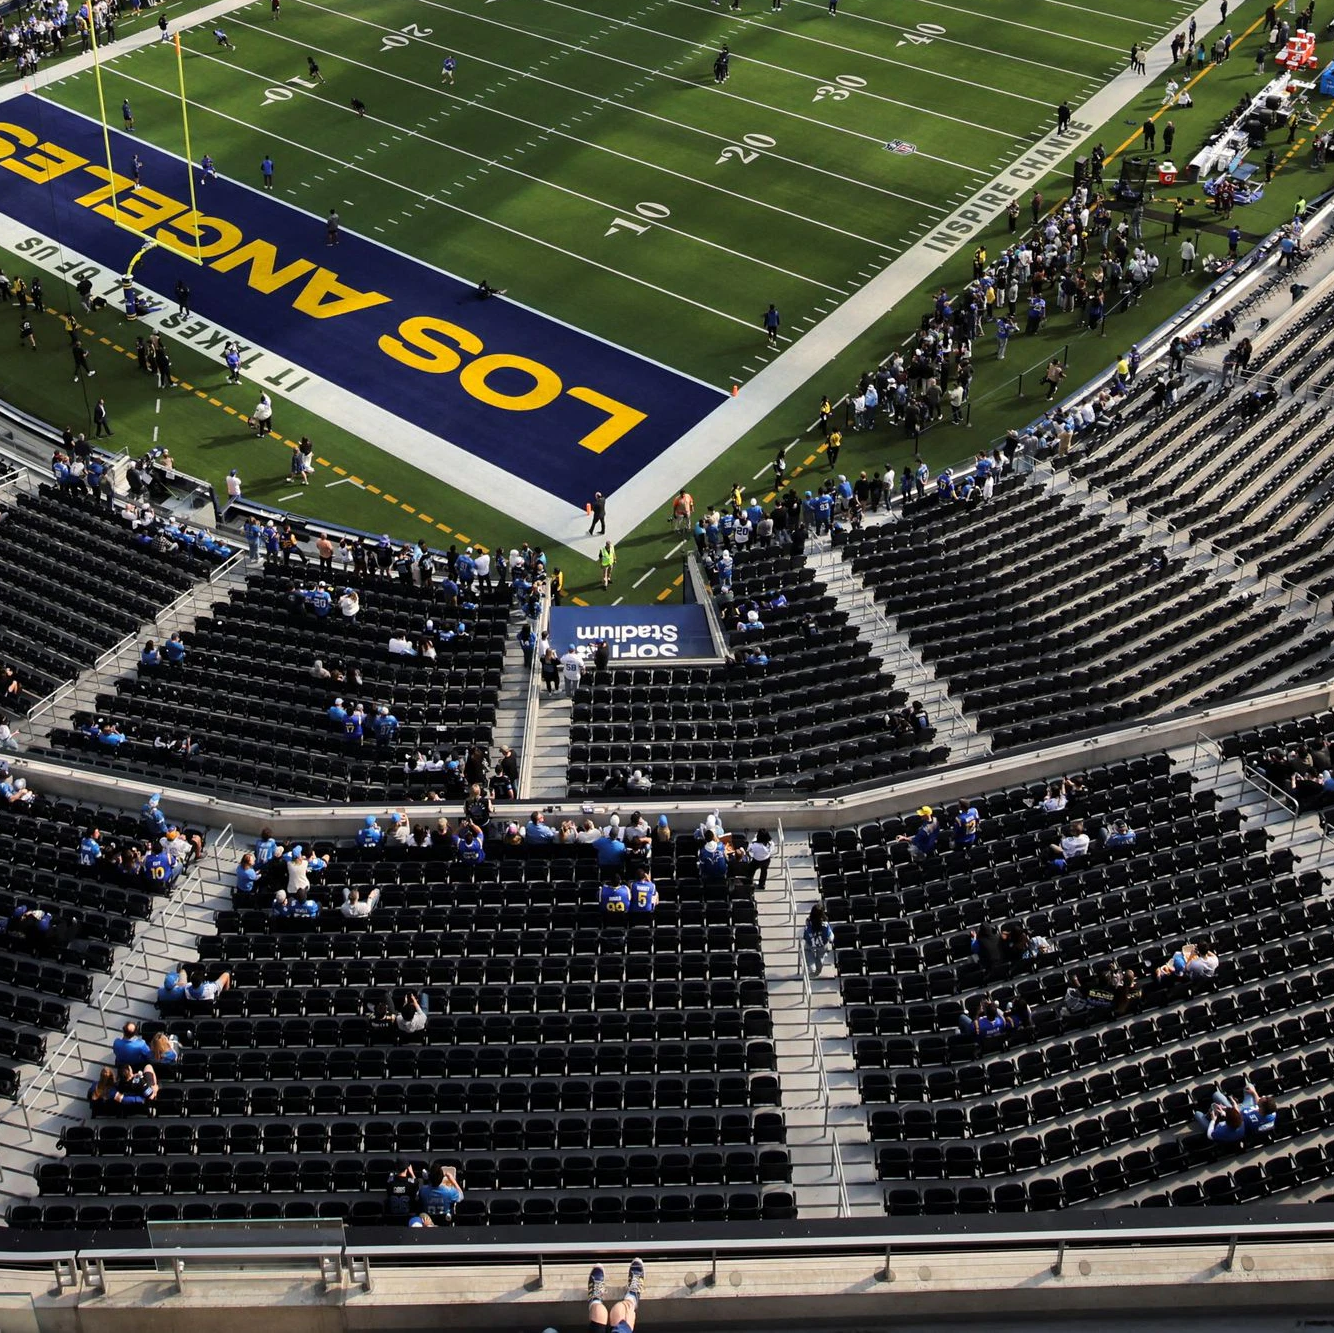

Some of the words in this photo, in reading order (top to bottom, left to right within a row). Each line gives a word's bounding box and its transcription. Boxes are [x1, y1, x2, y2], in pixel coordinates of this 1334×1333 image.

[380, 22, 433, 52] 20
[904, 23, 947, 45] 40
[263, 74, 318, 105] 10
[817, 74, 867, 100] 30
[725, 133, 777, 164] 20
[923, 172, 1013, 256] INSPIRE
[1011, 119, 1094, 181] CHANGE
[1164, 174, 1173, 182] G
[617, 202, 671, 236] 10
[15, 235, 44, 254] US
[57, 247, 100, 278] OF
[162, 310, 267, 376] TAKES
[263, 367, 310, 393] IT
[378, 315, 648, 455] LOS
[818, 502, 829, 512] 93
[736, 526, 749, 537] 20
[313, 597, 327, 608] 20
[576, 624, 679, 643] Stadium
[566, 662, 577, 672] 58
[150, 867, 165, 880] 10
[638, 892, 647, 908] 5
